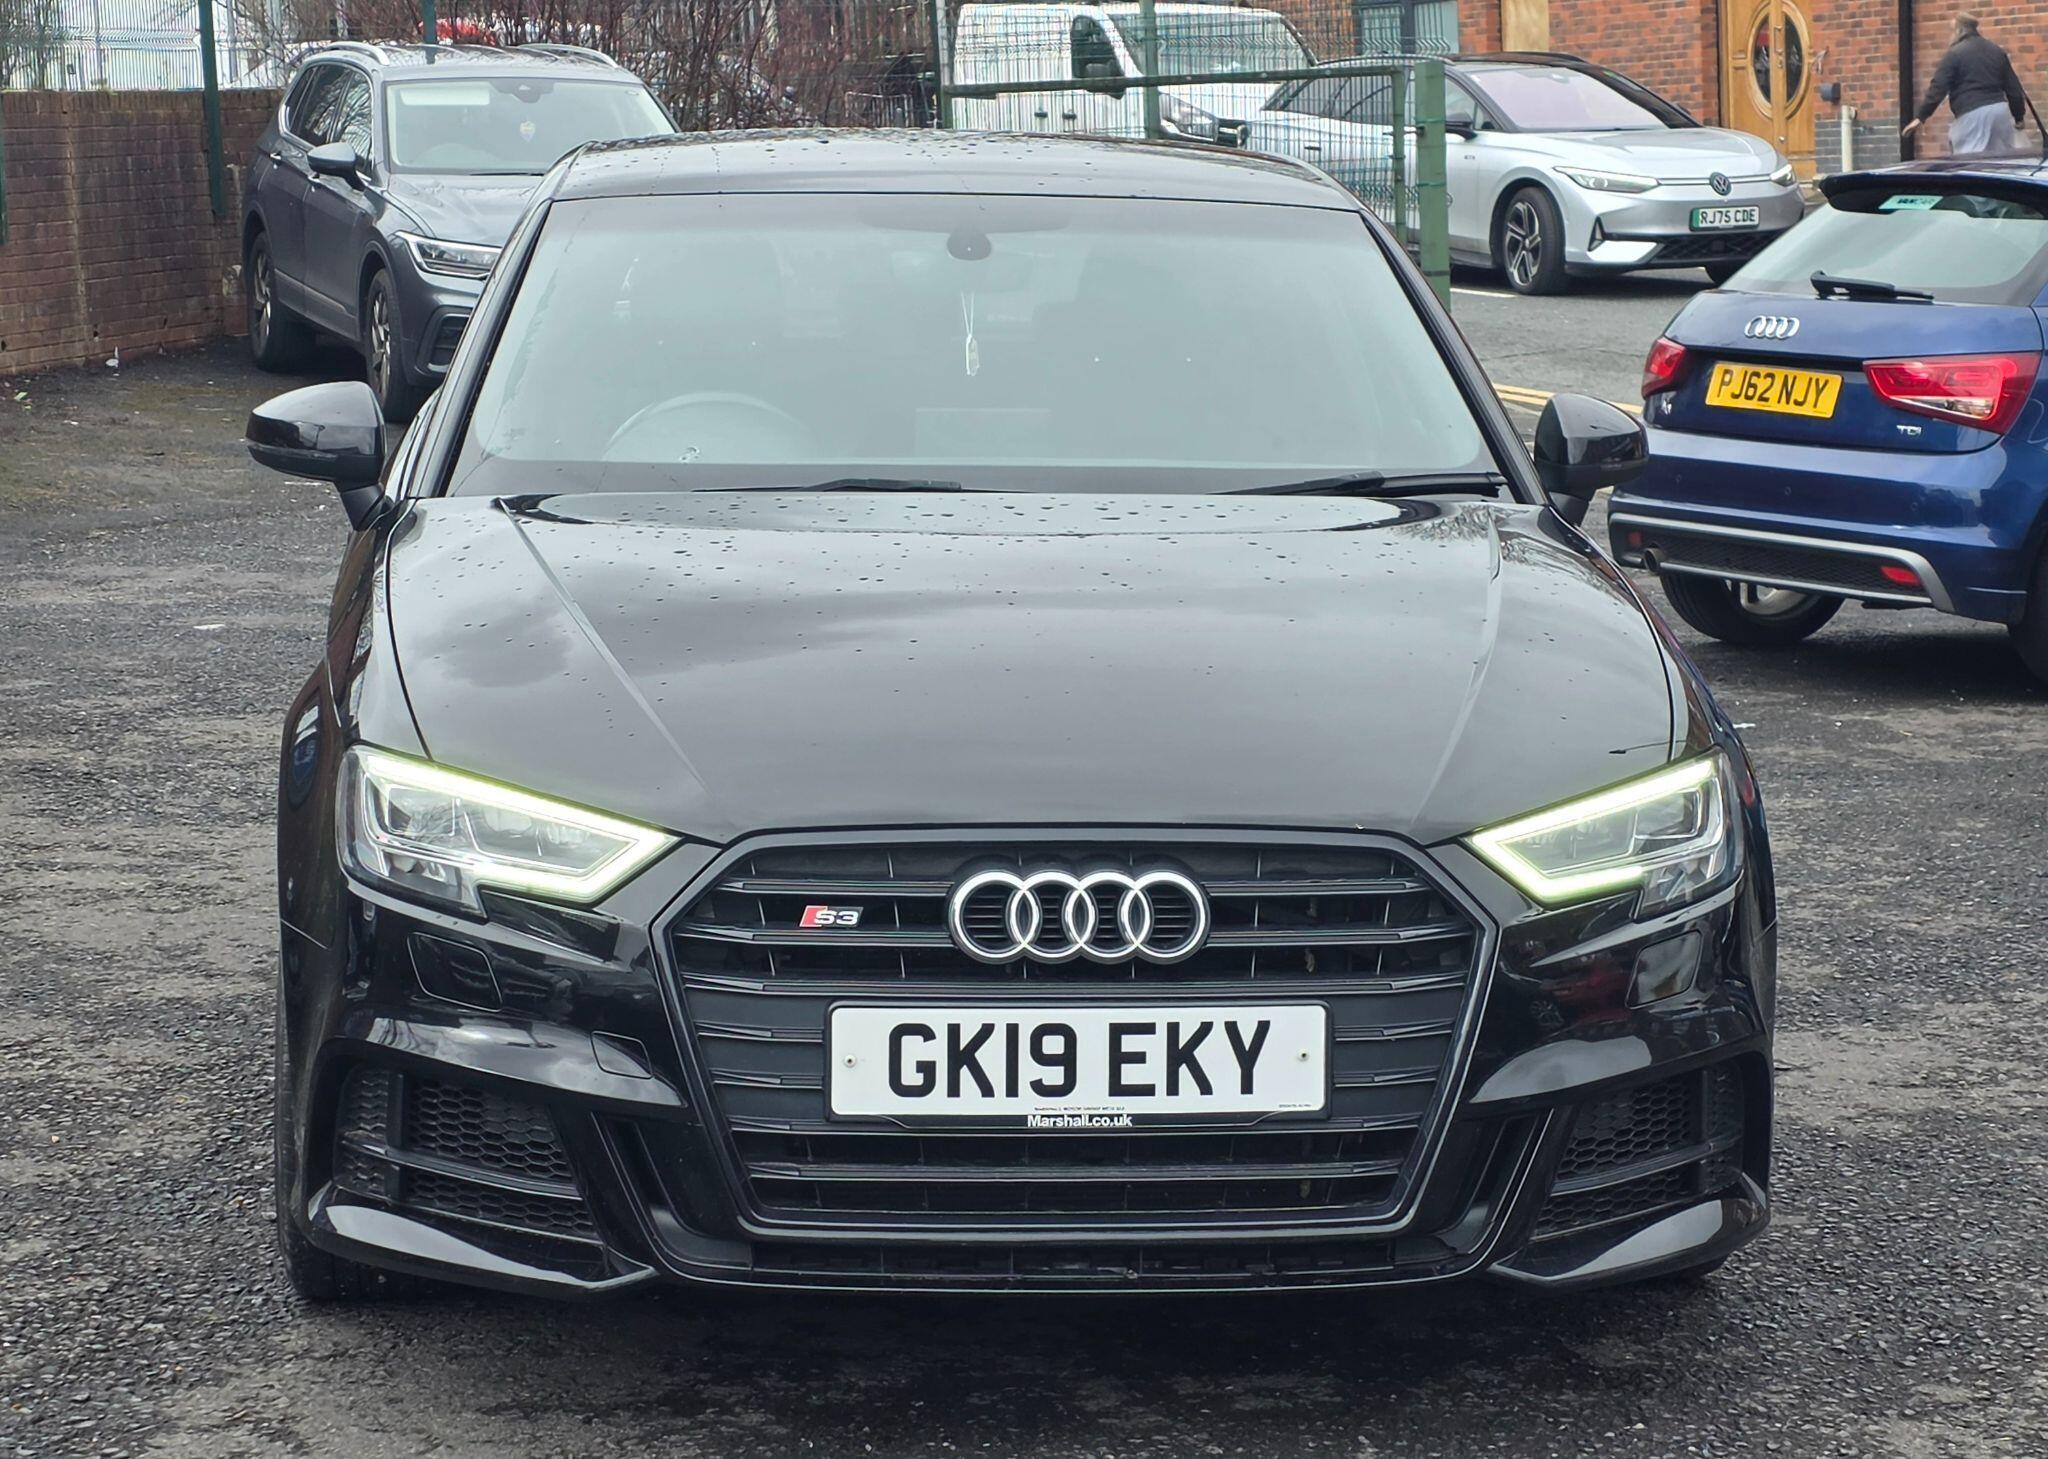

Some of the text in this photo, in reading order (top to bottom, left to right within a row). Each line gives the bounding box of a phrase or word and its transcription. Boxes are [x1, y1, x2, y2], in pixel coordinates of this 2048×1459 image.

[1700, 209, 1756, 224] RJ75 CDE
[1717, 368, 1829, 409] PJ62 NJY
[814, 909, 859, 925] S3
[888, 1019, 1272, 1099] GK19 EKY
[1027, 1113, 1133, 1128] Marshall.co.uk
